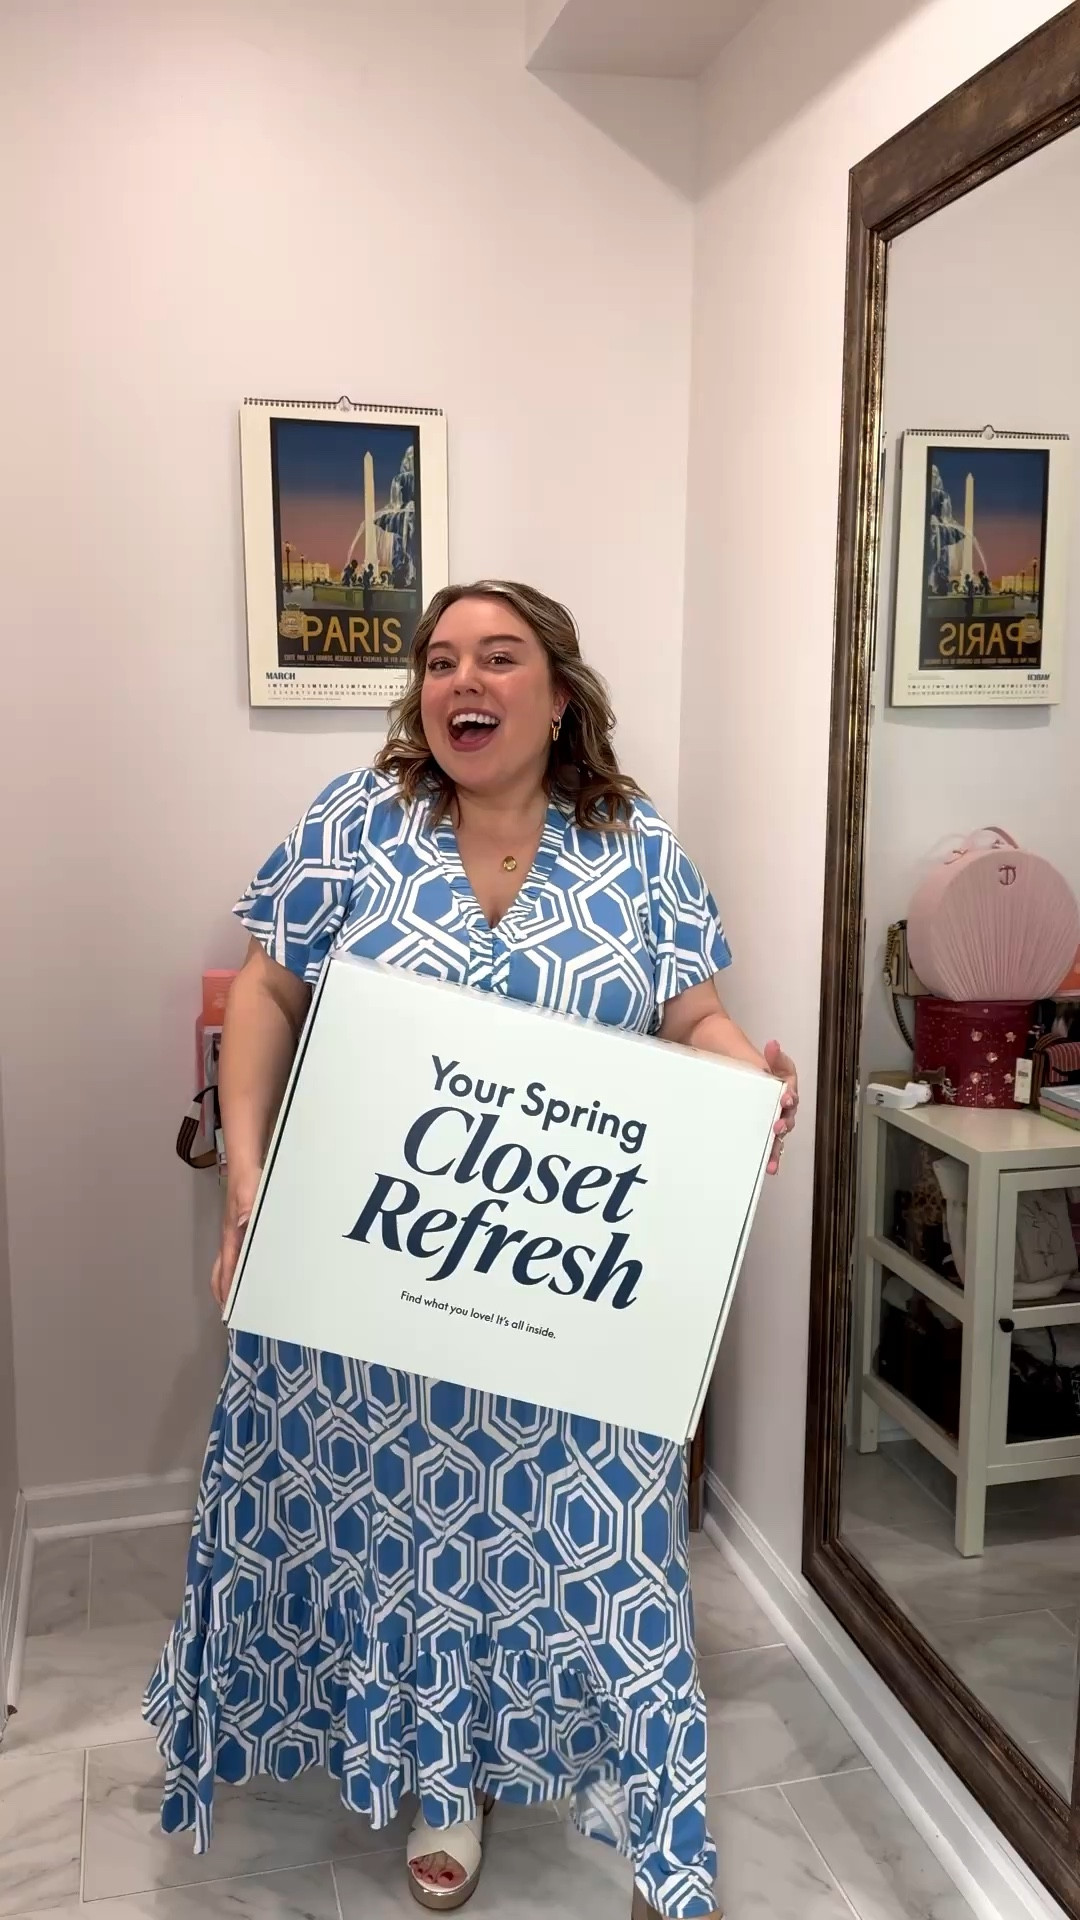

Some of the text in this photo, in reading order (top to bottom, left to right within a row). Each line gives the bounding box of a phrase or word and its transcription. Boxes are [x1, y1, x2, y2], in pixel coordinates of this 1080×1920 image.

[302, 615, 403, 654] PARIS
[266, 671, 296, 680] MARCH
[432, 1055, 648, 1154] Your Spring
[403, 1106, 649, 1224] Closet
[342, 1172, 644, 1310] Refresh
[400, 1290, 422, 1305] Find
[424, 1298, 449, 1311] what
[449, 1305, 469, 1316] you
[470, 1308, 494, 1323] love!
[511, 1320, 525, 1331] all
[525, 1323, 557, 1339] inside.
